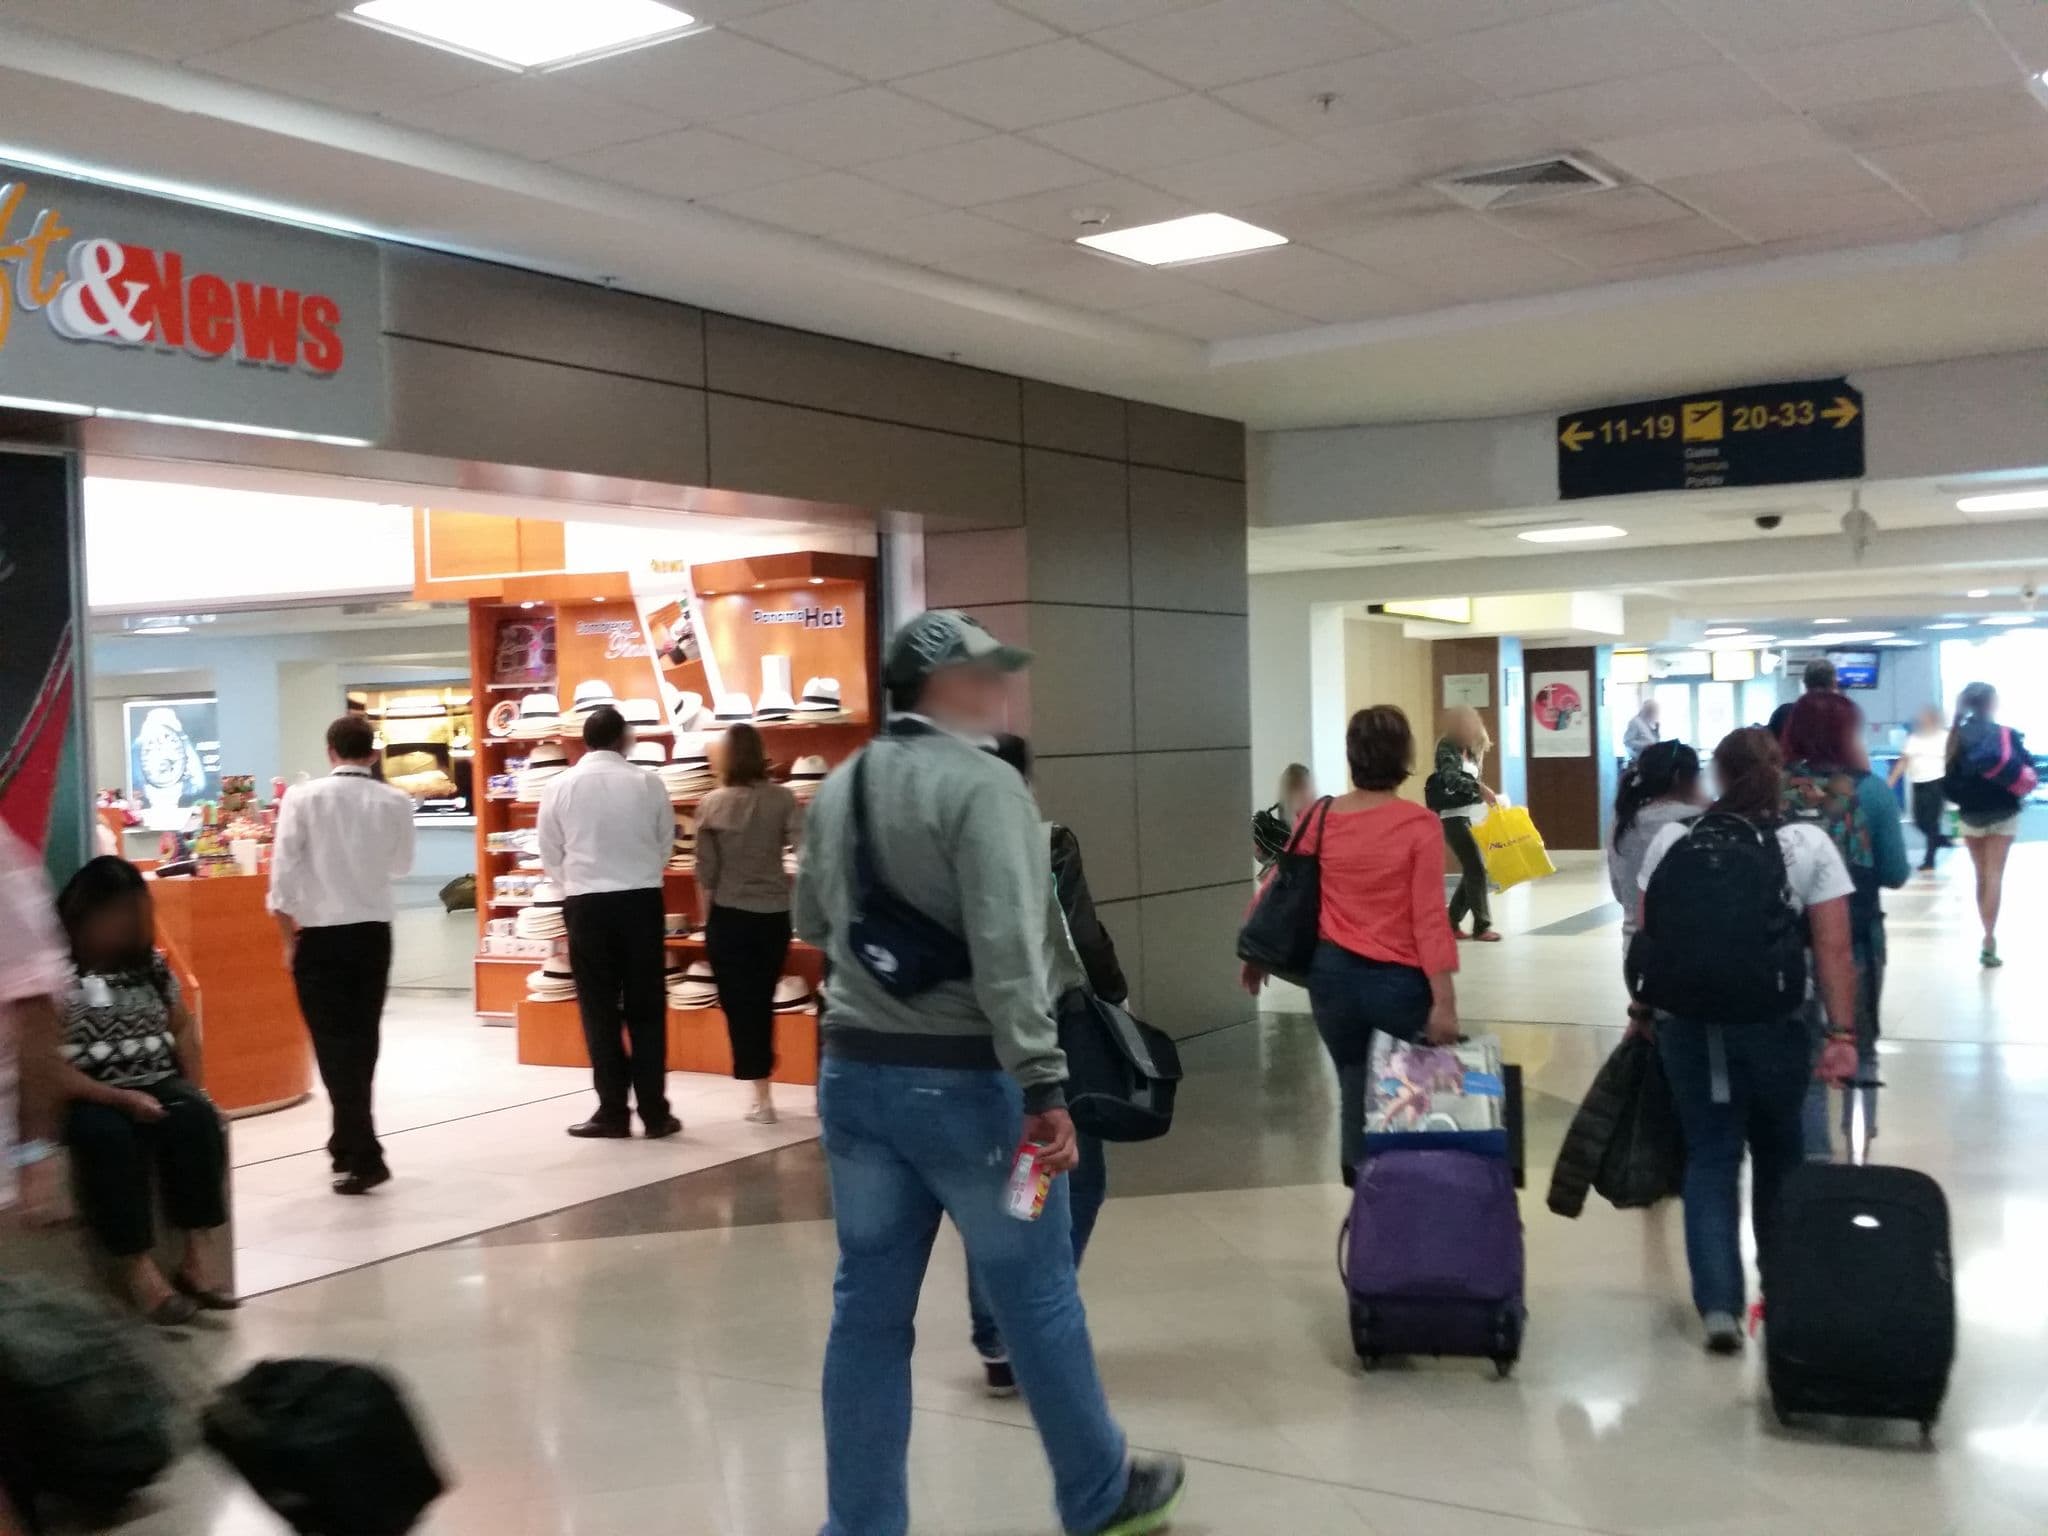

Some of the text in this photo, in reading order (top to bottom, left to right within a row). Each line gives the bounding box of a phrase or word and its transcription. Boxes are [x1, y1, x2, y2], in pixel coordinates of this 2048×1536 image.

[1599, 402, 1815, 444] 11-19 20-33
[804, 606, 844, 628] Hat
